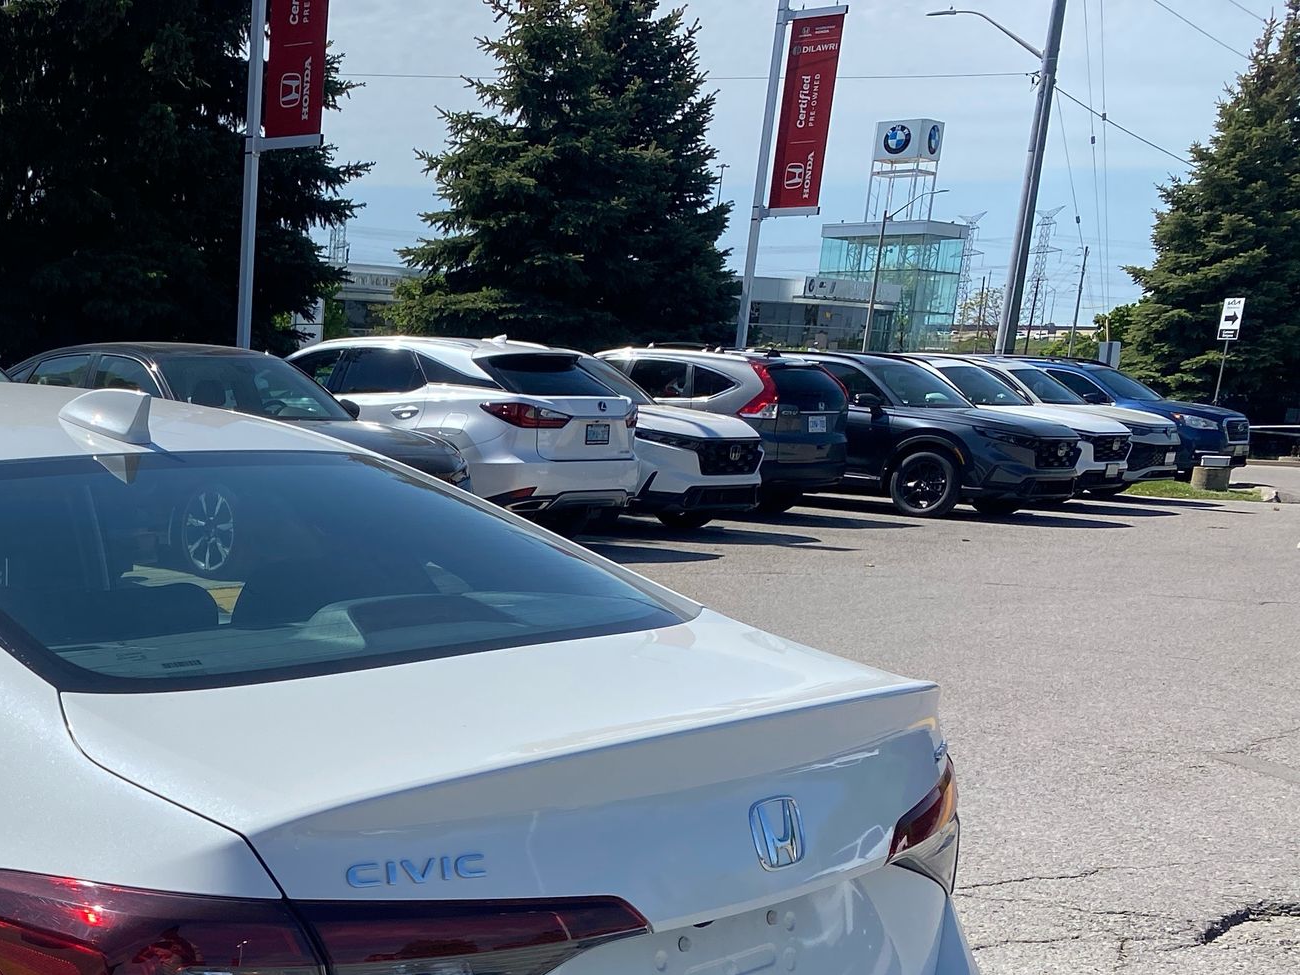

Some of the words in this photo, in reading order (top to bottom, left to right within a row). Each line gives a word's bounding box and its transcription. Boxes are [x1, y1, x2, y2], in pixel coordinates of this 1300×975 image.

[802, 42, 838, 54] DILAWRI
[301, 56, 312, 121] HONDA
[796, 75, 811, 128] Certified
[808, 73, 821, 127] PRE-OWNED
[803, 151, 815, 199] HONDA
[345, 853, 488, 889] CIVIC
